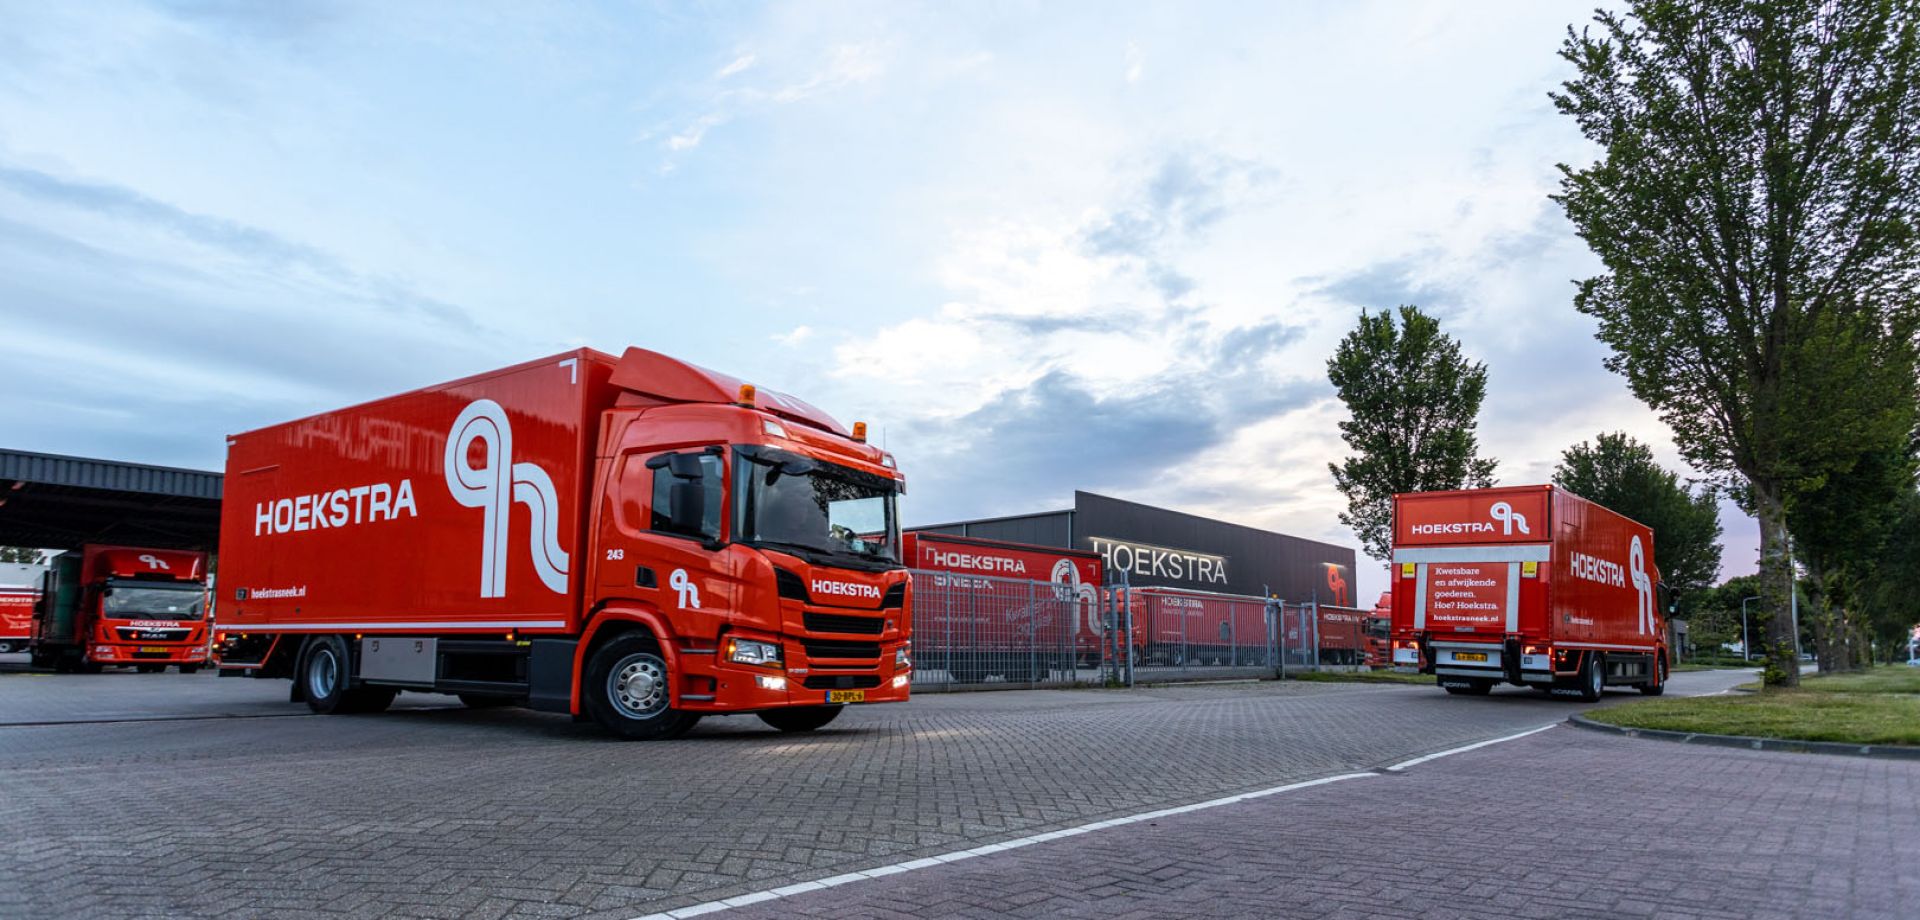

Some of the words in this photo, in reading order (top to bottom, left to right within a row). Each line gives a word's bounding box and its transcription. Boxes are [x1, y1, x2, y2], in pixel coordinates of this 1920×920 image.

[255, 479, 418, 537] HOEKSTRA
[1412, 523, 1495, 535] HOEKSTRA
[606, 549, 625, 561] 243
[934, 551, 1026, 574] HOEKSTRA
[1093, 540, 1229, 585] HOEKSTRA
[1435, 567, 1480, 576] Kwetsbare
[1570, 551, 1626, 588] HOEKSTRA
[811, 578, 881, 599] HOEKSTRA
[1447, 578, 1497, 588] afwijkende
[251, 585, 306, 599] hoekstrasneek.nl
[1434, 590, 1477, 600] goederen.
[1457, 602, 1499, 610] Hoekstra.
[1433, 614, 1499, 622] hoekstrasneek.nl
